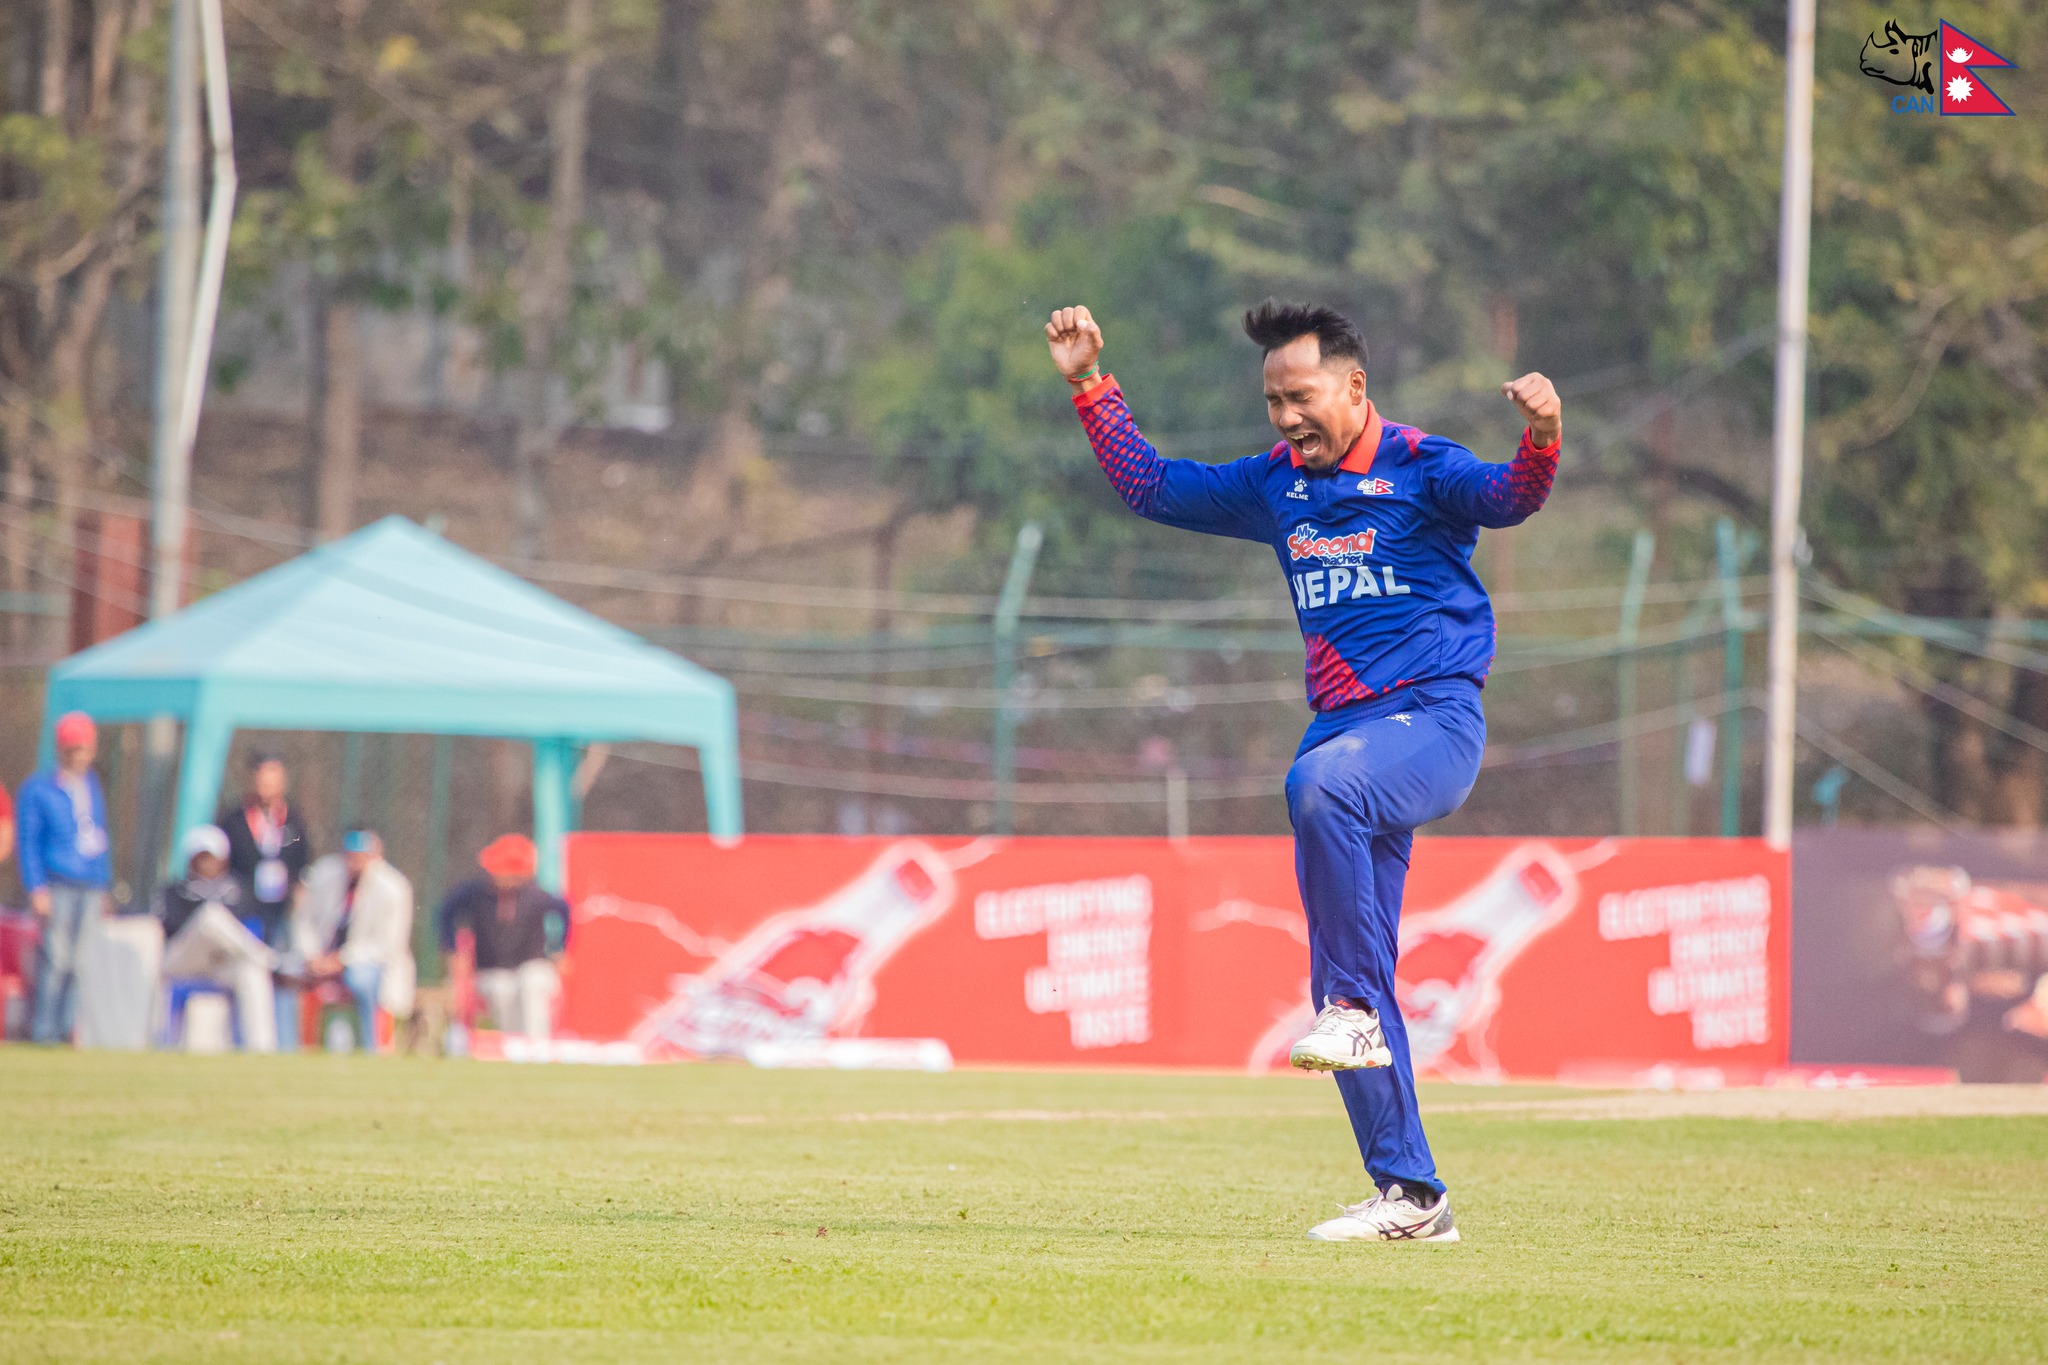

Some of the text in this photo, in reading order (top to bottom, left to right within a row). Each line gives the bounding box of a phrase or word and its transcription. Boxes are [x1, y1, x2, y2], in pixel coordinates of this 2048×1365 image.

[1286, 491, 1309, 500] KELME
[1288, 528, 1377, 561] Second
[1296, 523, 1318, 542] My
[1292, 565, 1411, 610] NEPAL
